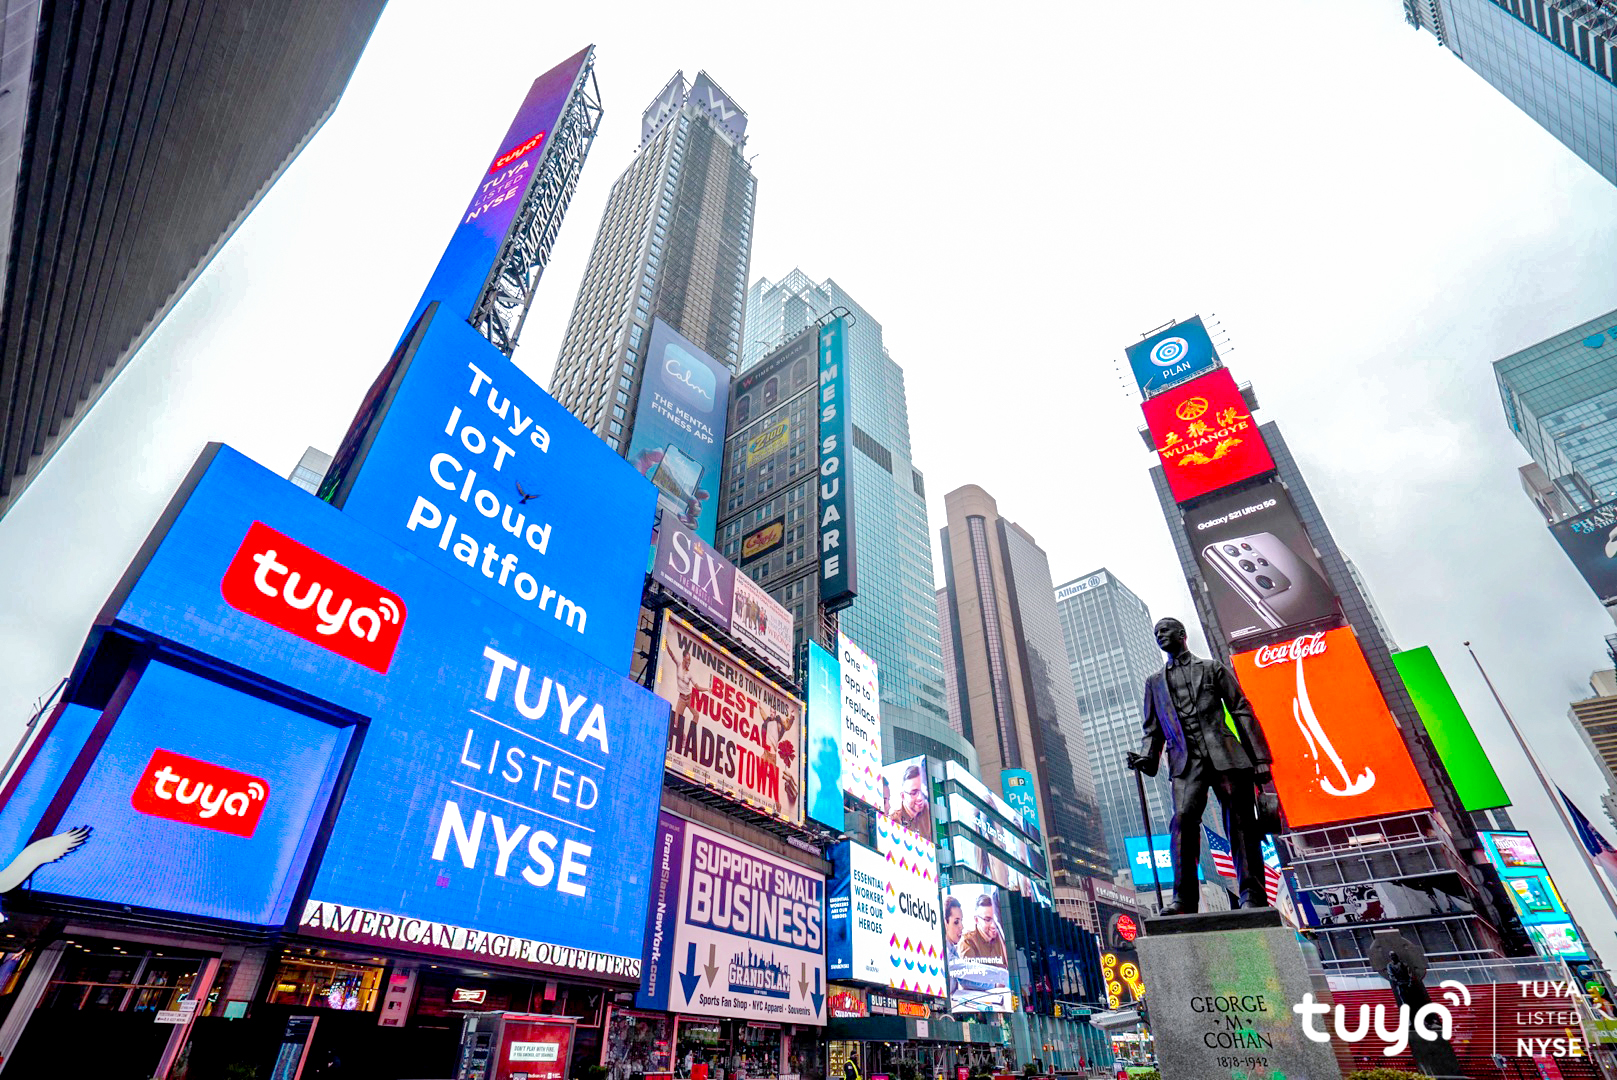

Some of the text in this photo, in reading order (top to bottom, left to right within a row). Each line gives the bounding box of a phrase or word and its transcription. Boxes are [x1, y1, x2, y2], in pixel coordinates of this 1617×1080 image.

[646, 82, 678, 129] W
[708, 85, 737, 120] W
[497, 139, 537, 167] tuya
[475, 174, 524, 207] LISTED
[483, 160, 529, 193] TUYA
[465, 185, 519, 223] NYSE
[520, 164, 563, 273] AMERICAN
[665, 360, 711, 400] Calm
[755, 365, 774, 380] TIMES
[1162, 360, 1191, 379] PLAN
[467, 361, 552, 454] Tuya
[651, 401, 714, 445] FITNESS APP
[654, 392, 714, 437] THE MENTAL
[444, 405, 517, 473] IoT
[820, 330, 840, 580] TIMES SQUARE
[1162, 421, 1249, 458] WULIANGYE
[429, 452, 553, 555] Cloud
[1197, 499, 1277, 530] Galaxy S21 Ultra 5G
[406, 495, 588, 634] Platform
[668, 531, 724, 605] SIX
[253, 549, 384, 642] tuya
[1058, 582, 1087, 599] Allianz
[844, 650, 861, 673] One
[1254, 631, 1327, 668] Coca-Cola
[677, 631, 738, 685] WINNER!
[738, 674, 744, 688] 8
[744, 675, 762, 701] TONY
[763, 687, 789, 717] AWARDS
[844, 673, 871, 701] app to
[483, 646, 609, 754] TUYA
[711, 675, 758, 719] BEST
[845, 695, 876, 726] replace
[690, 687, 771, 752] MUSICAL
[845, 716, 868, 742] them
[846, 740, 859, 759] all.
[460, 729, 599, 810] LISTED
[154, 765, 250, 819] tuya
[431, 800, 592, 897] NYSE
[695, 841, 773, 891] SUPPORT
[774, 869, 820, 906] SMALL
[853, 869, 884, 891] ESSENTIAL
[690, 871, 821, 950] BUSINESS
[854, 884, 884, 905] WORKERS
[857, 901, 883, 920] ARE OUR
[899, 892, 937, 930] ClickUp
[648, 834, 674, 997] GrandSlamNewYork.com
[858, 917, 883, 934] HEROES
[303, 901, 641, 978] AMERICAN EAGLE OUTFITTERS
[699, 994, 811, 1016] Sports Fan Shop NYC Apparel Souvenirs
[887, 998, 897, 1008] FIN
[1191, 995, 1267, 1013] GEORGE
[1203, 1032, 1273, 1049] COHAN
[1226, 1014, 1243, 1030] M
[1216, 1056, 1268, 1070] 1878-1942
